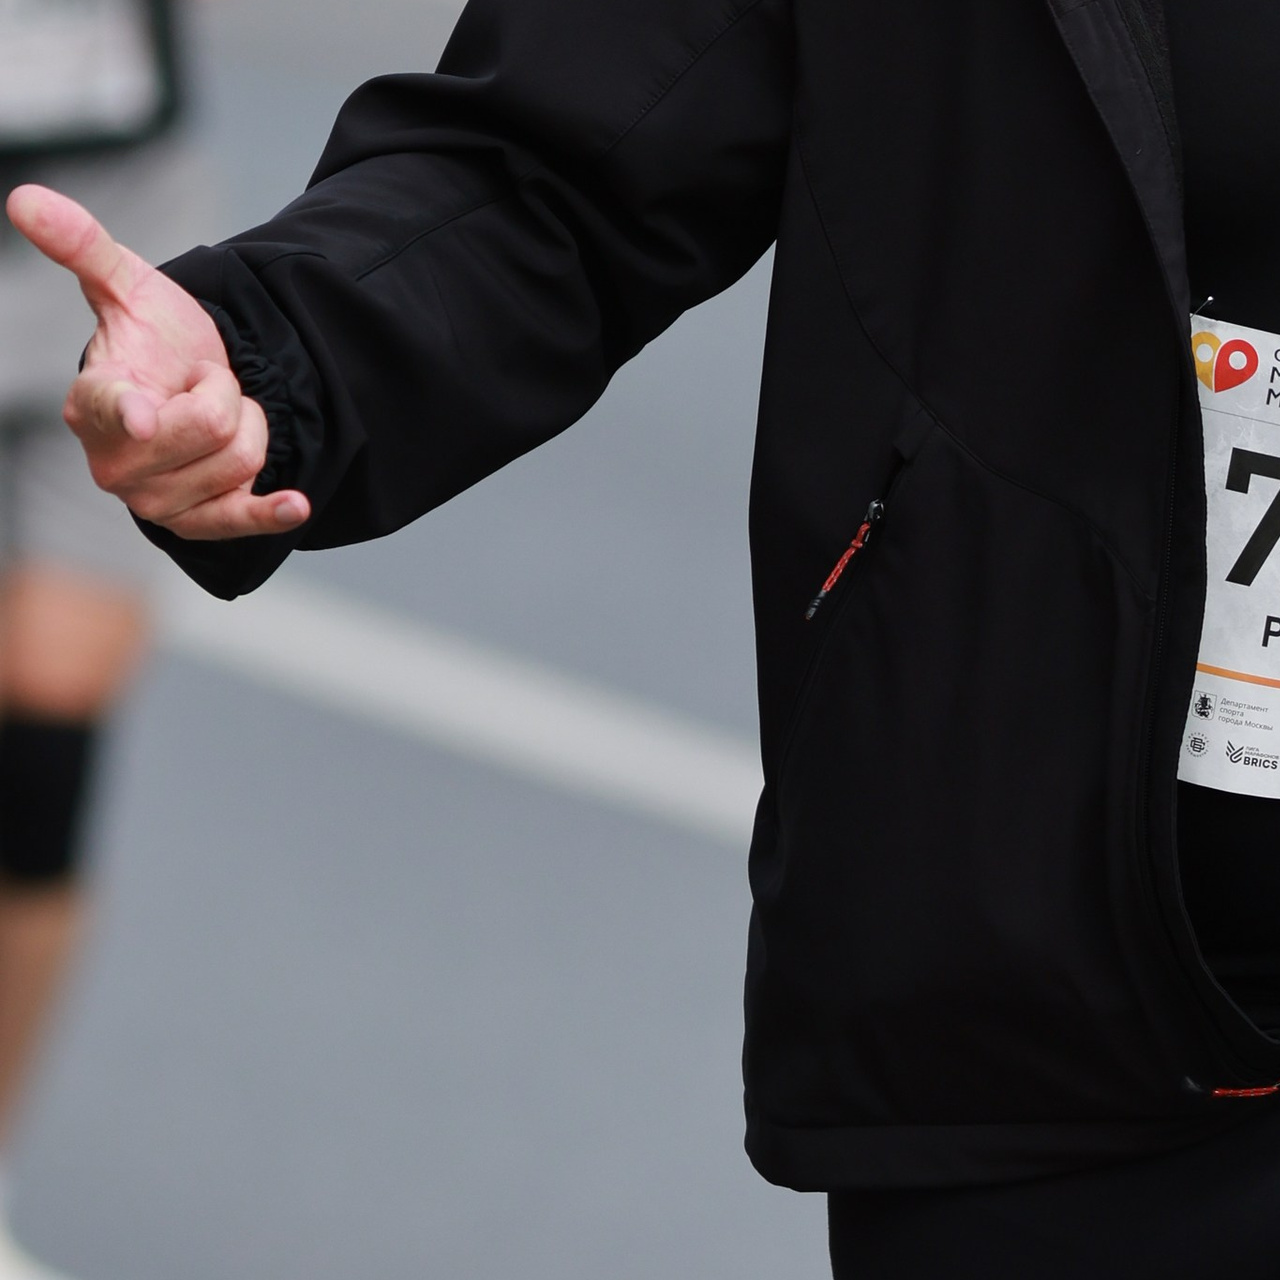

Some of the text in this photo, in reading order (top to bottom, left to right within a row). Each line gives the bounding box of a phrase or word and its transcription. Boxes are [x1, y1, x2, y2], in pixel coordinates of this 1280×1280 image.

[1219, 706, 1244, 717] спорта
[1220, 697, 1269, 713] Департамент
[1218, 715, 1274, 731] города Москвы
[1243, 756, 1279, 770] BRICS
